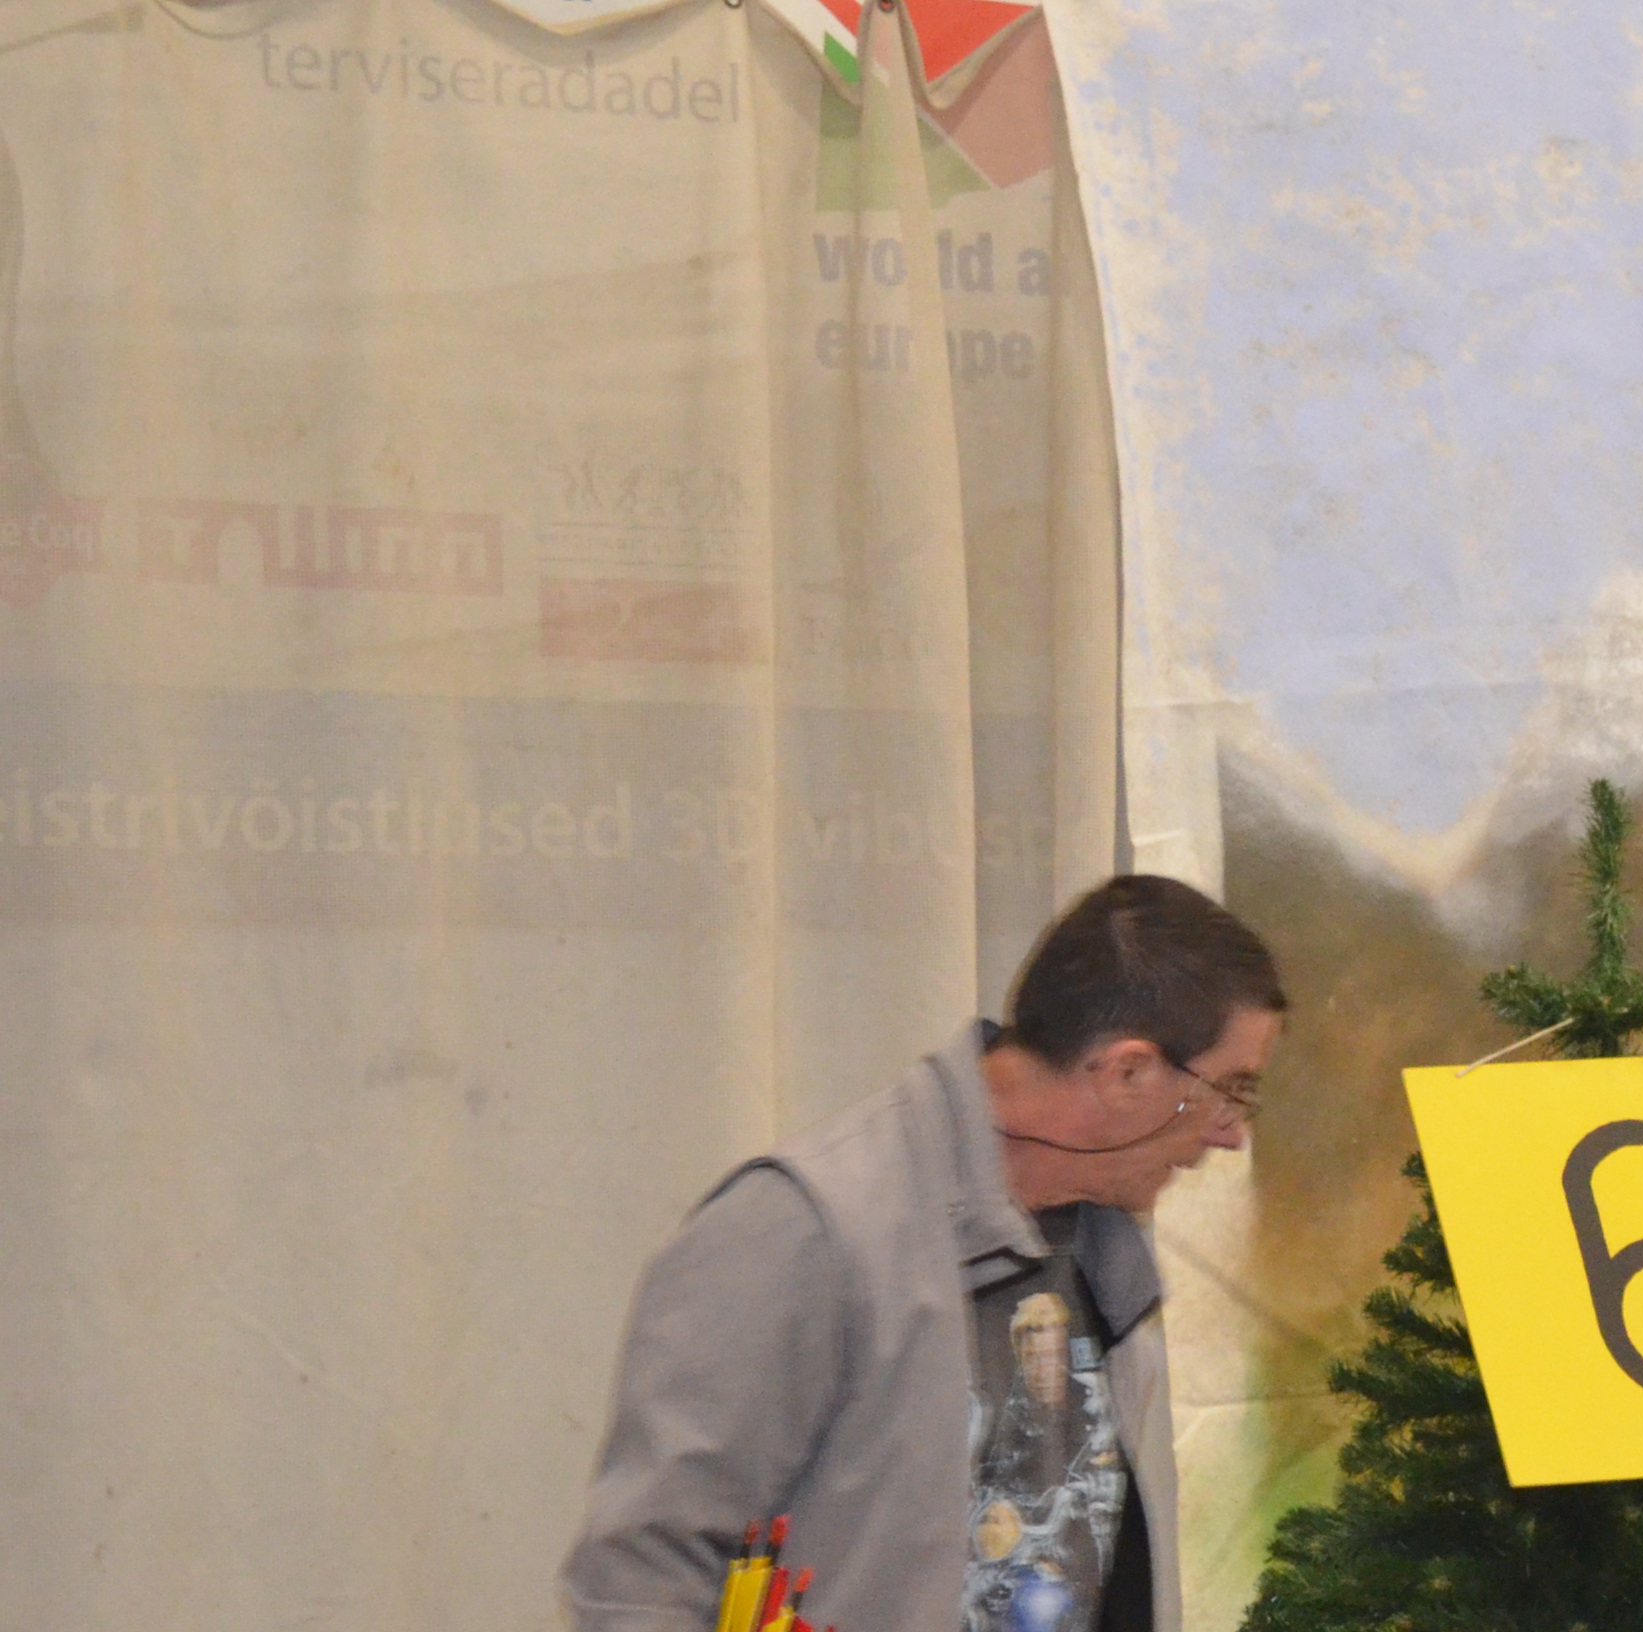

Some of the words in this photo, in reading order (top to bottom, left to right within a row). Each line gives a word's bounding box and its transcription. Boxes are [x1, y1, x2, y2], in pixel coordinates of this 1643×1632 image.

[812, 229, 994, 293] wold
[815, 319, 1035, 384] eurpe
[0, 768, 632, 862] istrivõistlused
